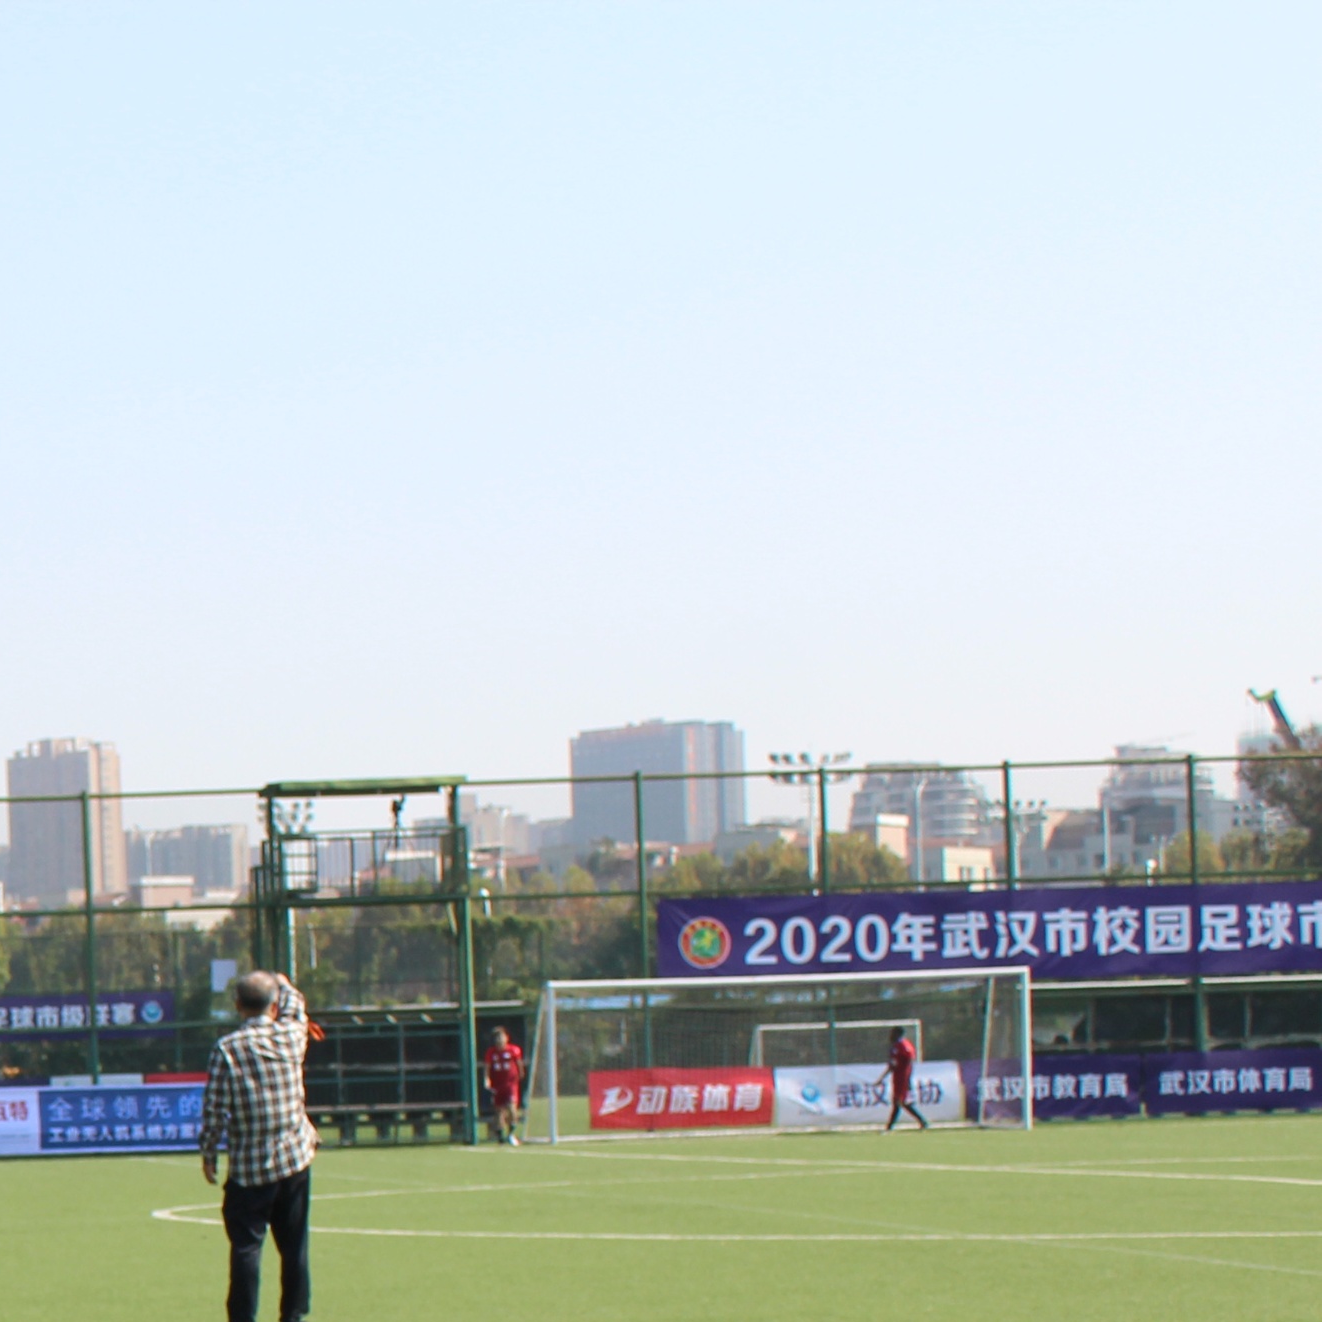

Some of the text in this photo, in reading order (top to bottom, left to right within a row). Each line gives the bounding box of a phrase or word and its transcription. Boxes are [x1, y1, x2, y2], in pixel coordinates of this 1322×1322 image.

[837, 1079, 943, 1108] 武汉协
[977, 1073, 1129, 1101] 武汉市教育局
[1158, 1066, 1313, 1096] 武汉市体育局
[48, 1094, 204, 1122] 全球领先的
